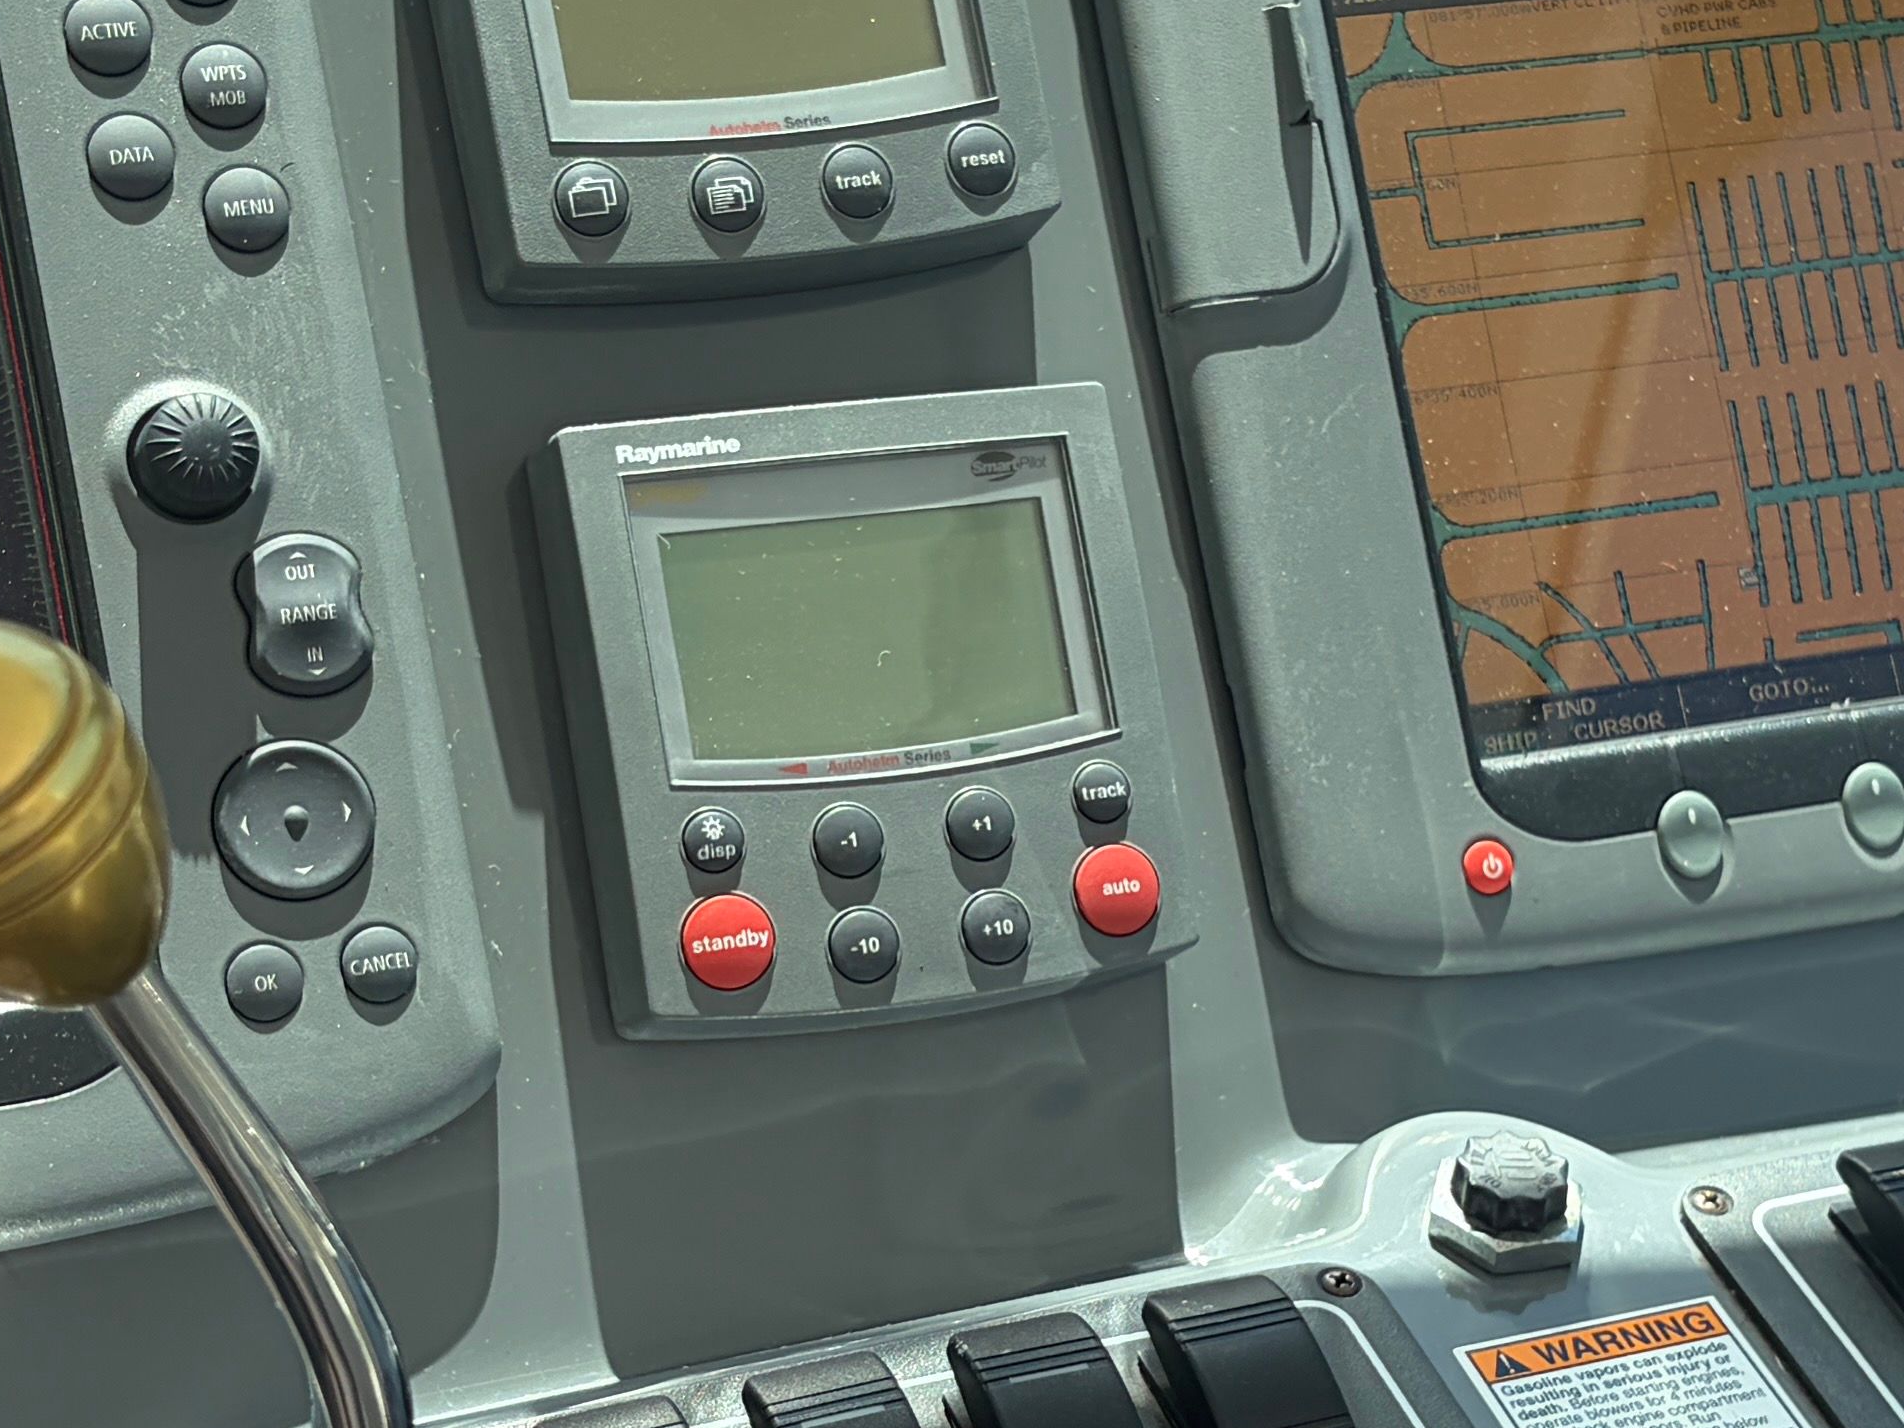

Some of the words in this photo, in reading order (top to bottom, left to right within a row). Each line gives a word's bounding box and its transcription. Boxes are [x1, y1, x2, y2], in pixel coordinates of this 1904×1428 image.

[80, 21, 138, 42] ACTIVE
[201, 65, 246, 82] WPTS
[209, 90, 246, 107] MOB
[109, 146, 154, 165] DATA
[961, 150, 1006, 168] reset
[835, 170, 882, 190] track
[223, 198, 275, 218] MENU
[615, 436, 740, 465] Raymarine
[285, 563, 316, 581] OUT
[280, 603, 337, 624] RANGE
[308, 647, 323, 662] IN
[905, 748, 951, 766] Series
[1082, 782, 1126, 801] track
[973, 816, 991, 832] +1
[841, 834, 858, 848] -1
[697, 841, 736, 860] disp
[1102, 879, 1140, 896] auto
[982, 920, 1013, 936] +10
[692, 929, 769, 954] standby
[850, 939, 879, 955] -10
[349, 952, 413, 976] CANCEL
[255, 974, 279, 991] OK
[1531, 1311, 1715, 1365] WARNING
[1501, 1372, 1572, 1396] Gasoline
[1575, 1360, 1630, 1381] vapors
[1633, 1355, 1662, 1370] can
[1665, 1341, 1728, 1362] explode
